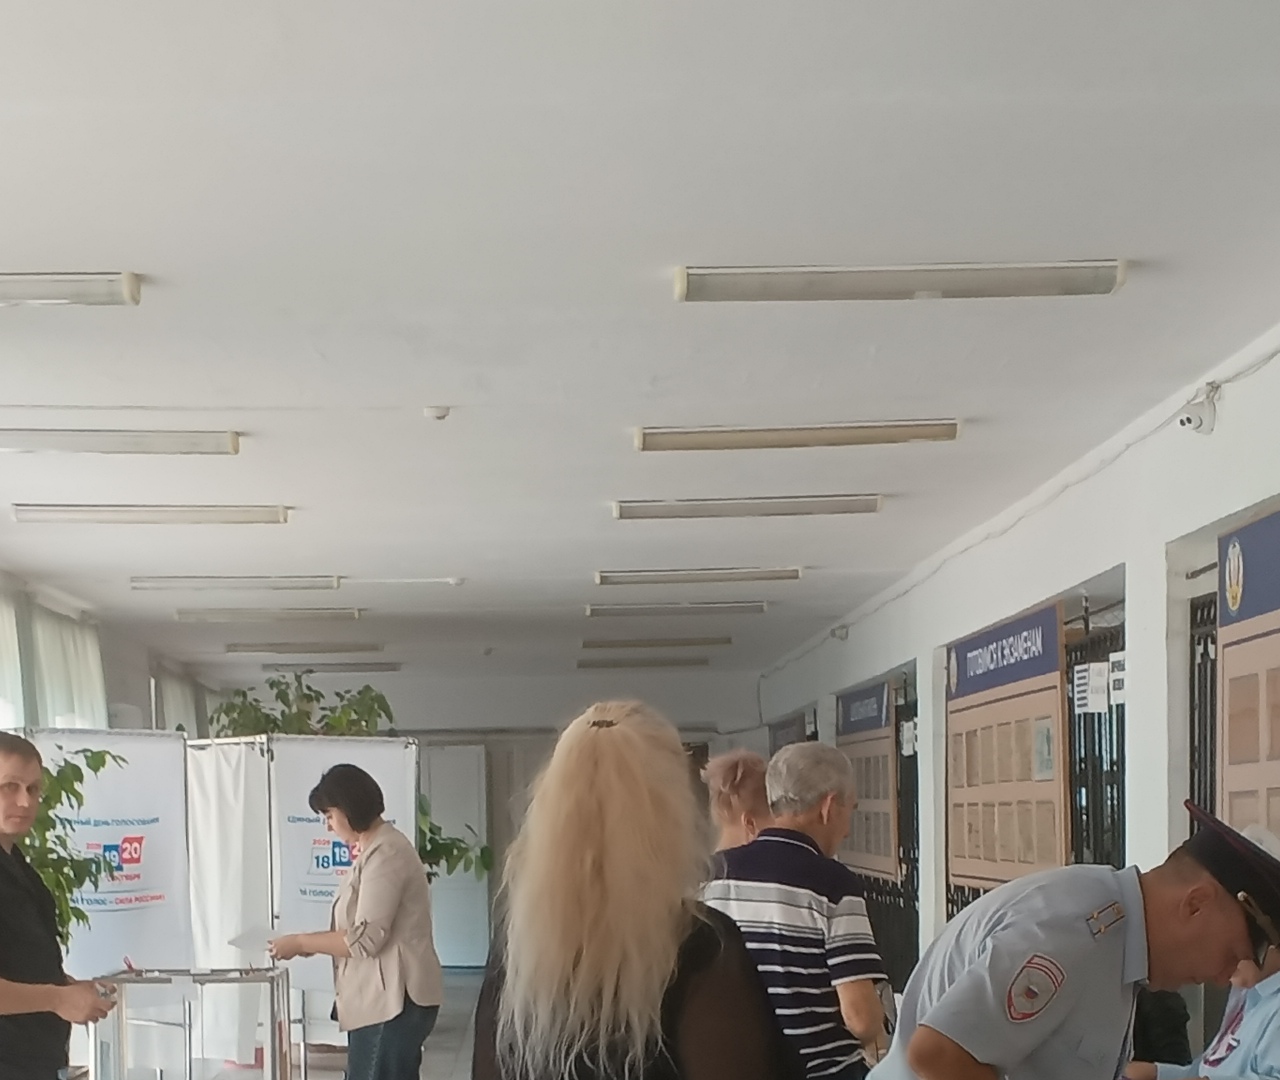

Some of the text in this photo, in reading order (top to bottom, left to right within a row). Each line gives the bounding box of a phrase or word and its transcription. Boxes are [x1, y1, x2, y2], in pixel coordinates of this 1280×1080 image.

[122, 841, 140, 859] 20
[314, 854, 331, 870] 18
[333, 847, 349, 863] 19
